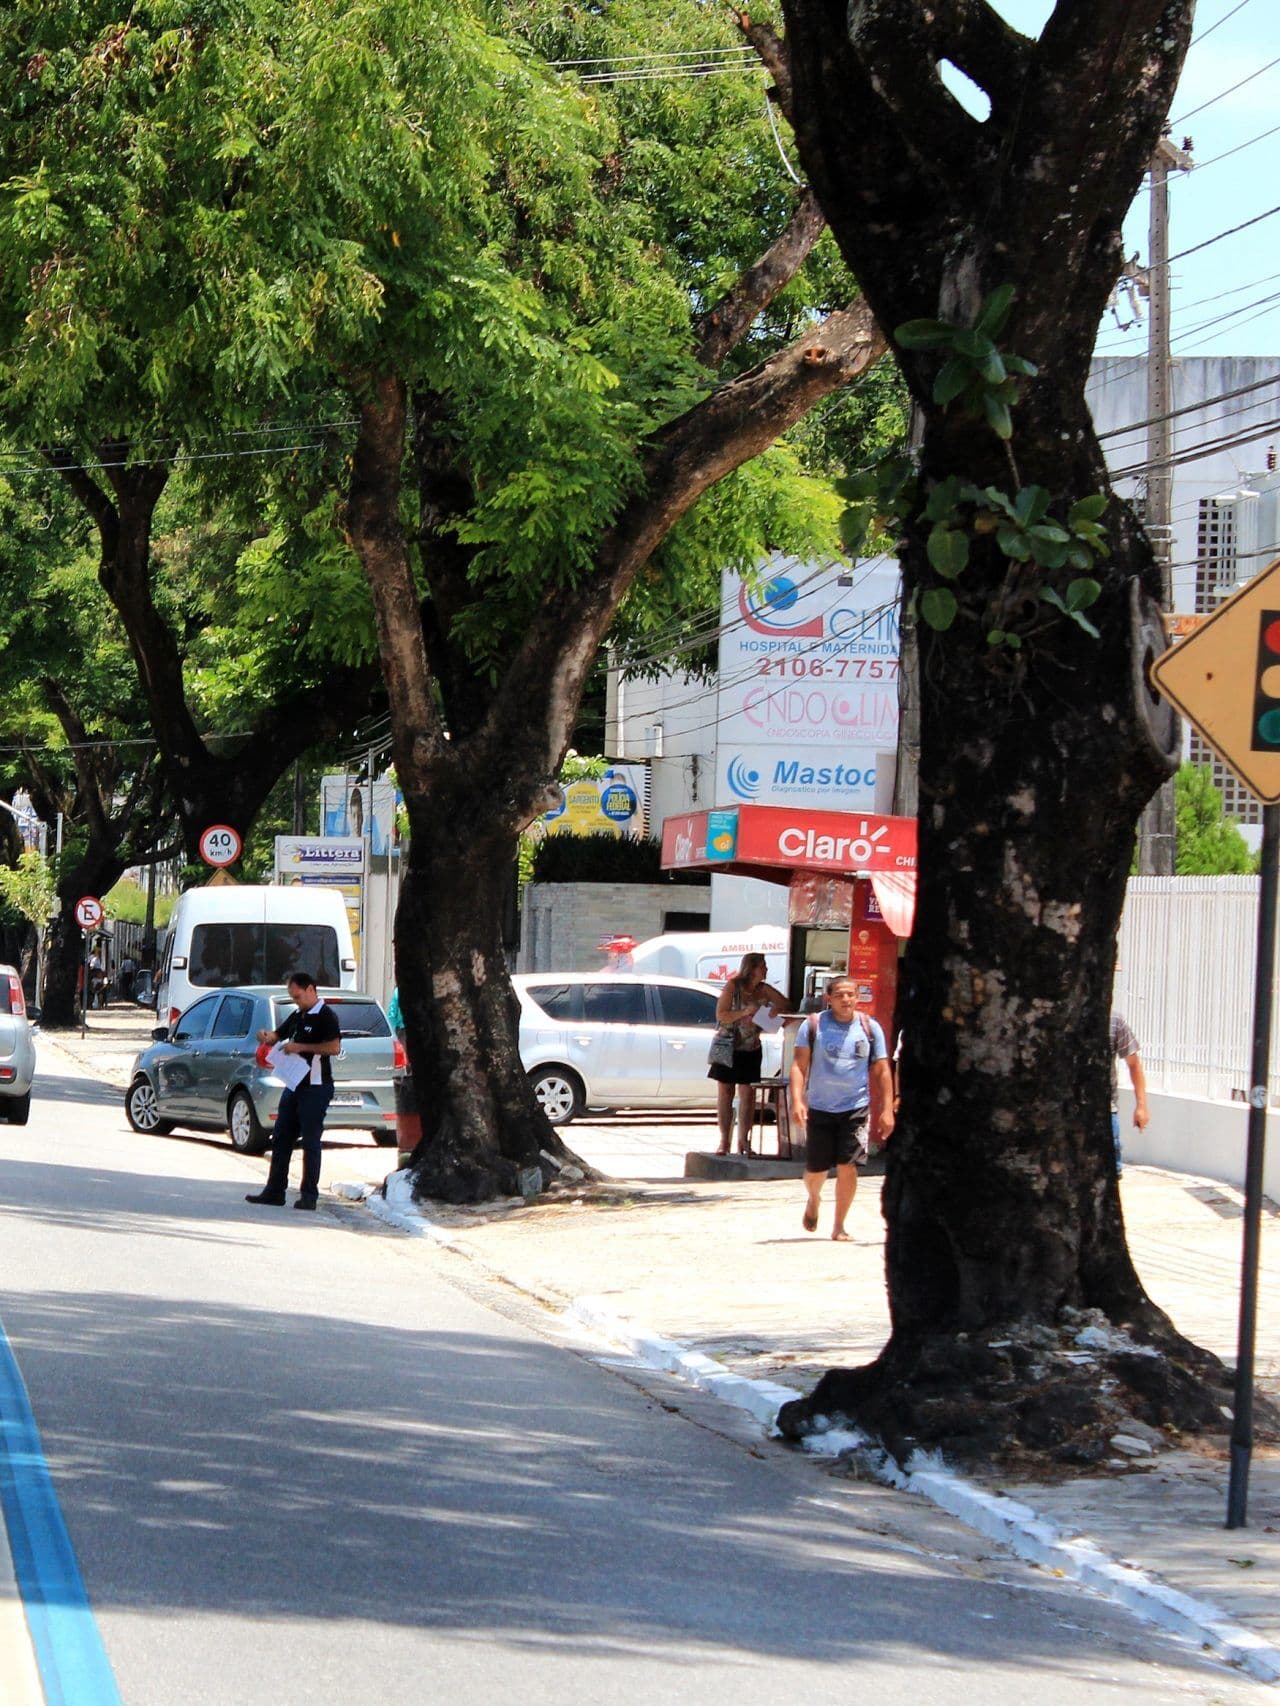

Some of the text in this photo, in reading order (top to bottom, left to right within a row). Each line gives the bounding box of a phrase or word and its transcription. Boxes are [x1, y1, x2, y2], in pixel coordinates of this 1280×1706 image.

[740, 641, 802, 652] HOSPITAL
[822, 643, 899, 656] MATERNIDA
[758, 656, 900, 679] 2106-7757
[209, 833, 231, 847] 40
[209, 849, 232, 857] km/h
[305, 847, 361, 858] Littera
[778, 828, 917, 867] Claro CHI
